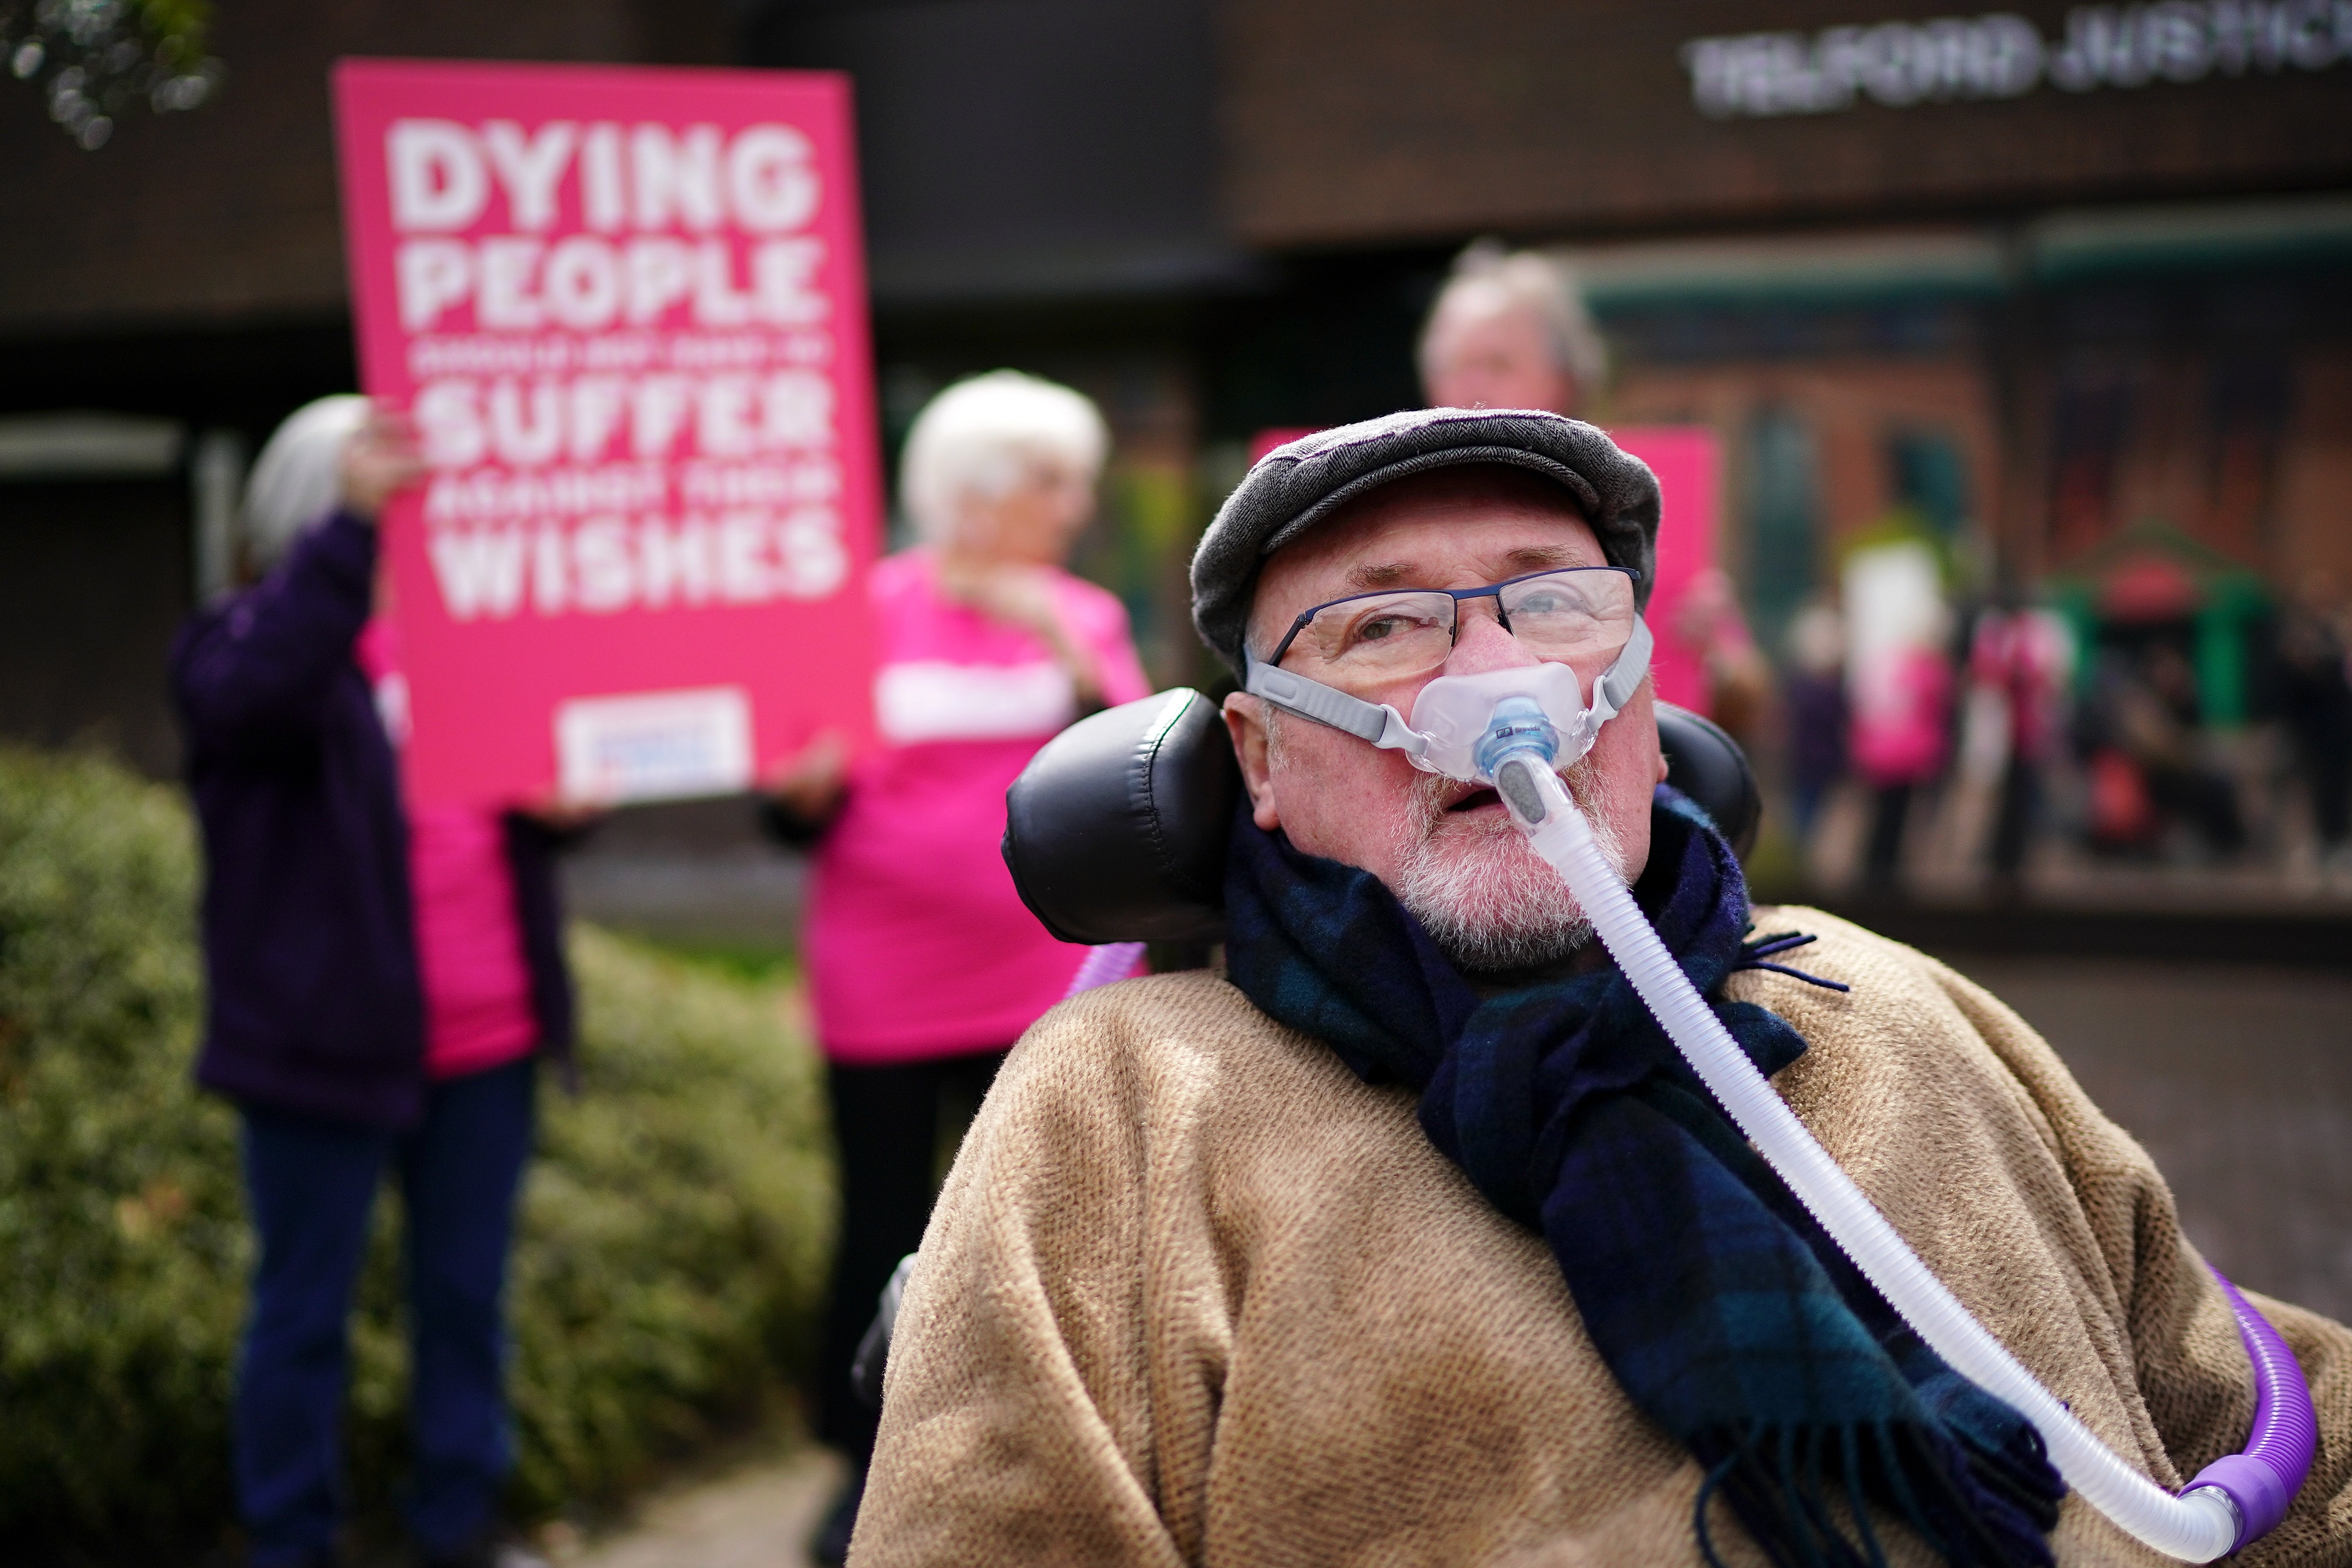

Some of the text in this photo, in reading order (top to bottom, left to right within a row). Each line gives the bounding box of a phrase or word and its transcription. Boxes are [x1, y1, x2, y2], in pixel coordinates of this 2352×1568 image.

[1683, 15, 2044, 118] TELFORD
[387, 118, 819, 232] DYING
[397, 236, 830, 333] PEOPLE
[416, 371, 833, 468] SUFFER
[430, 511, 847, 620] WISHES
